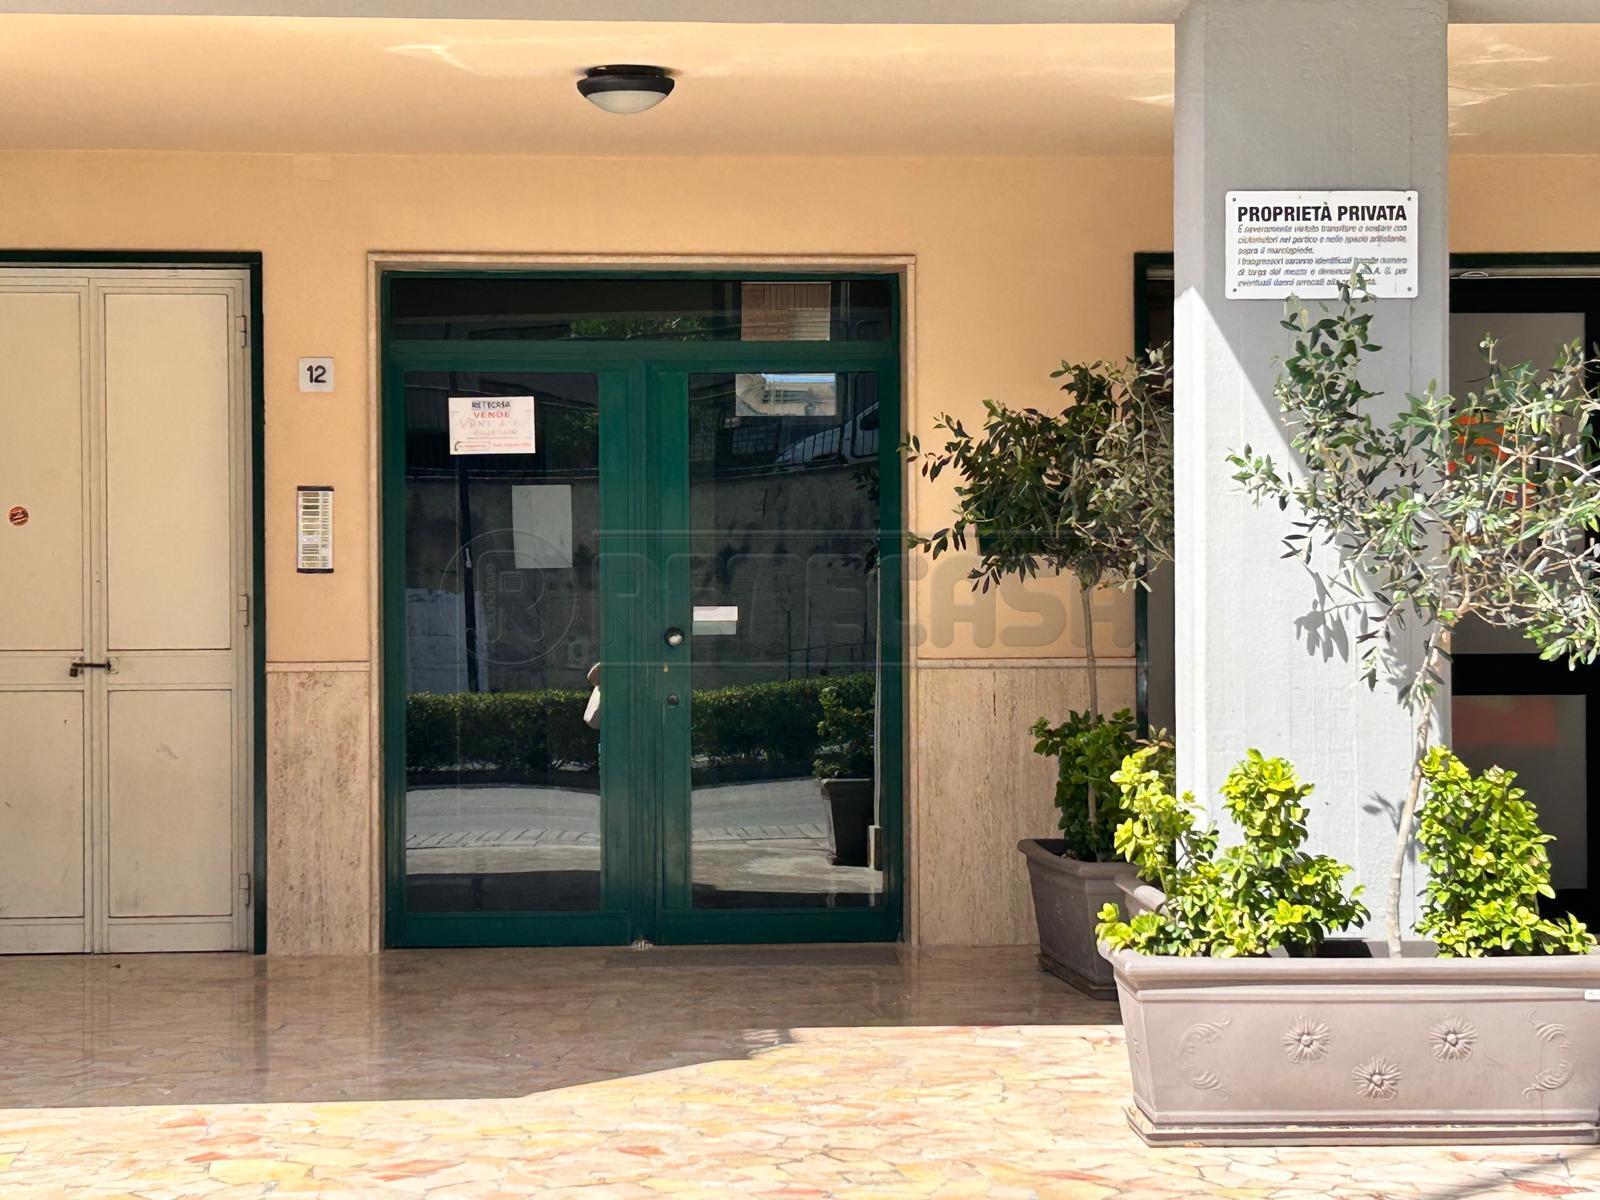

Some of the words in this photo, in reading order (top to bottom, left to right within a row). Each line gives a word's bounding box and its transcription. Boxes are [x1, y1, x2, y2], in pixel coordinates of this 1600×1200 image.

[1238, 202, 1332, 222] PROPRIETÀ
[1338, 205, 1407, 221] PRIVATA
[307, 365, 327, 383] 12
